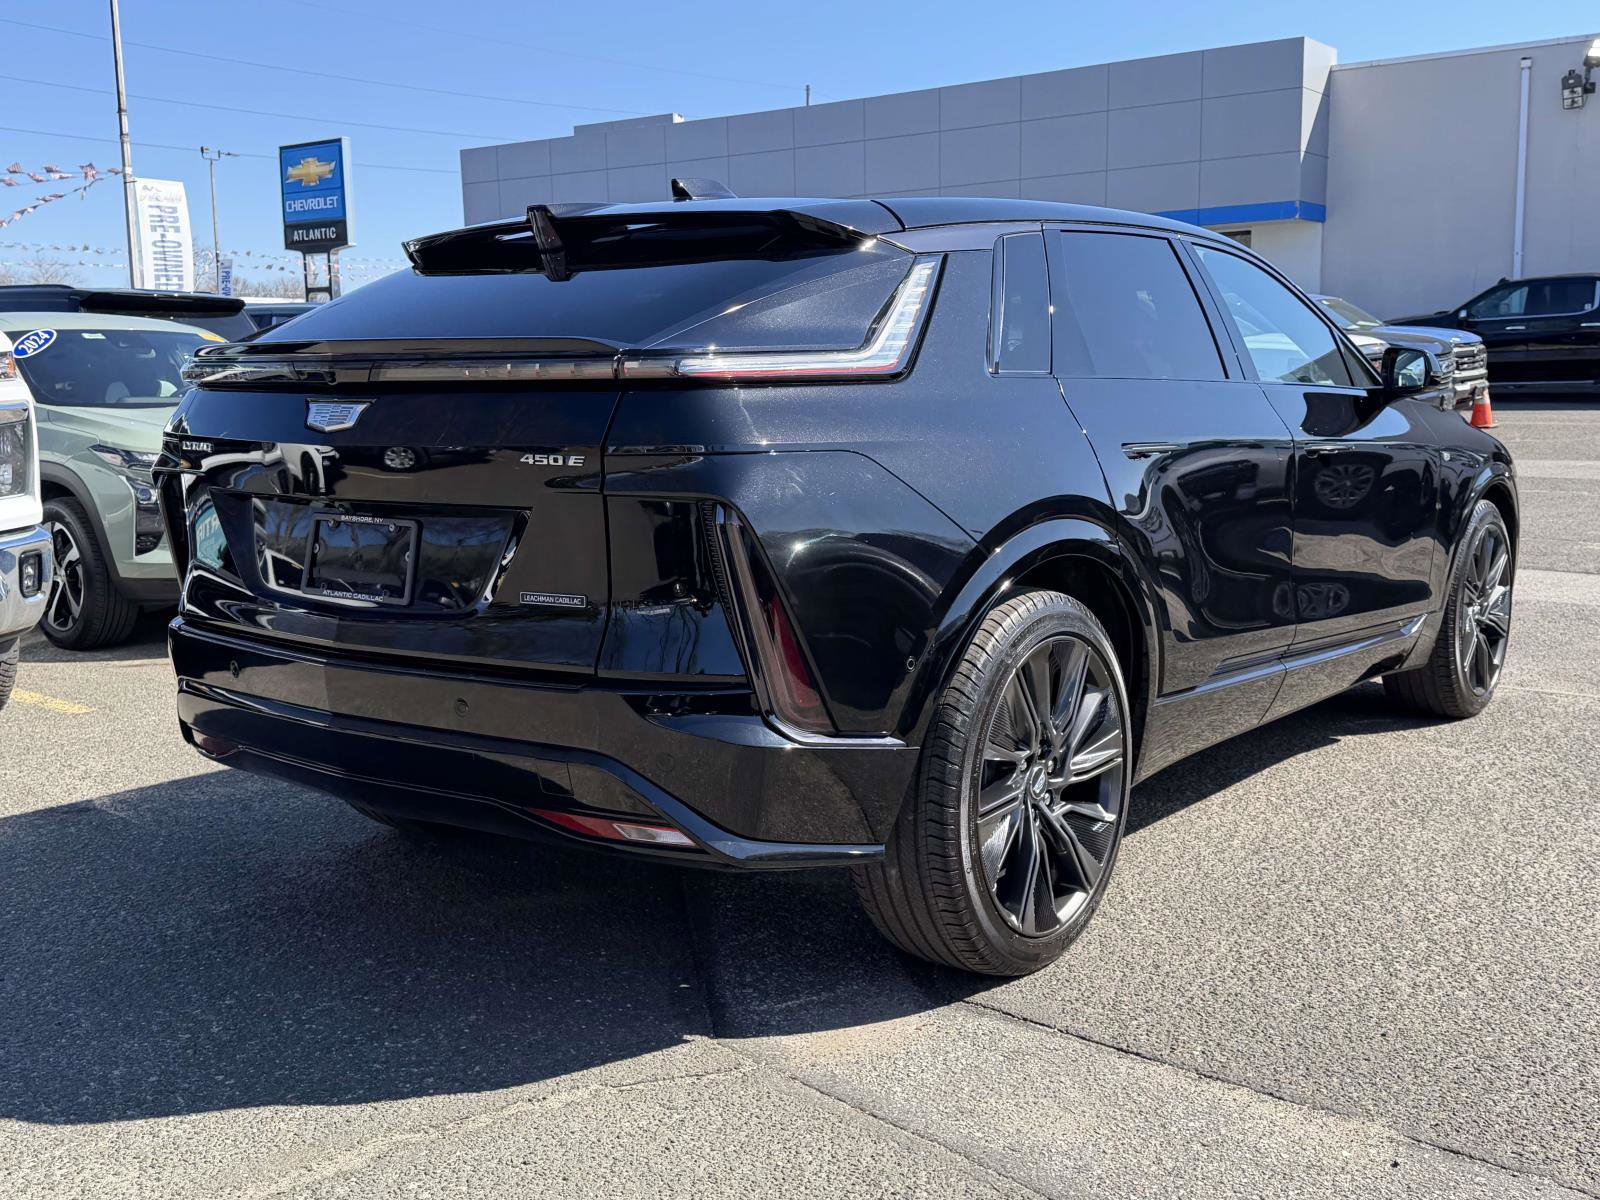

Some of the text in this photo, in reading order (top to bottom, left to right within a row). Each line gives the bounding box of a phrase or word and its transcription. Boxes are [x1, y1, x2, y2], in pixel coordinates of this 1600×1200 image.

[286, 196, 338, 212] CHEVROLET
[293, 227, 336, 242] ATLANTIC
[18, 330, 50, 353] 2024
[520, 454, 585, 466] 450 E
[341, 515, 373, 523] BAYSHORE,
[322, 589, 384, 602] ATLANTIC CADILLAC
[523, 594, 581, 605] LEACHMAN CADILLAC
